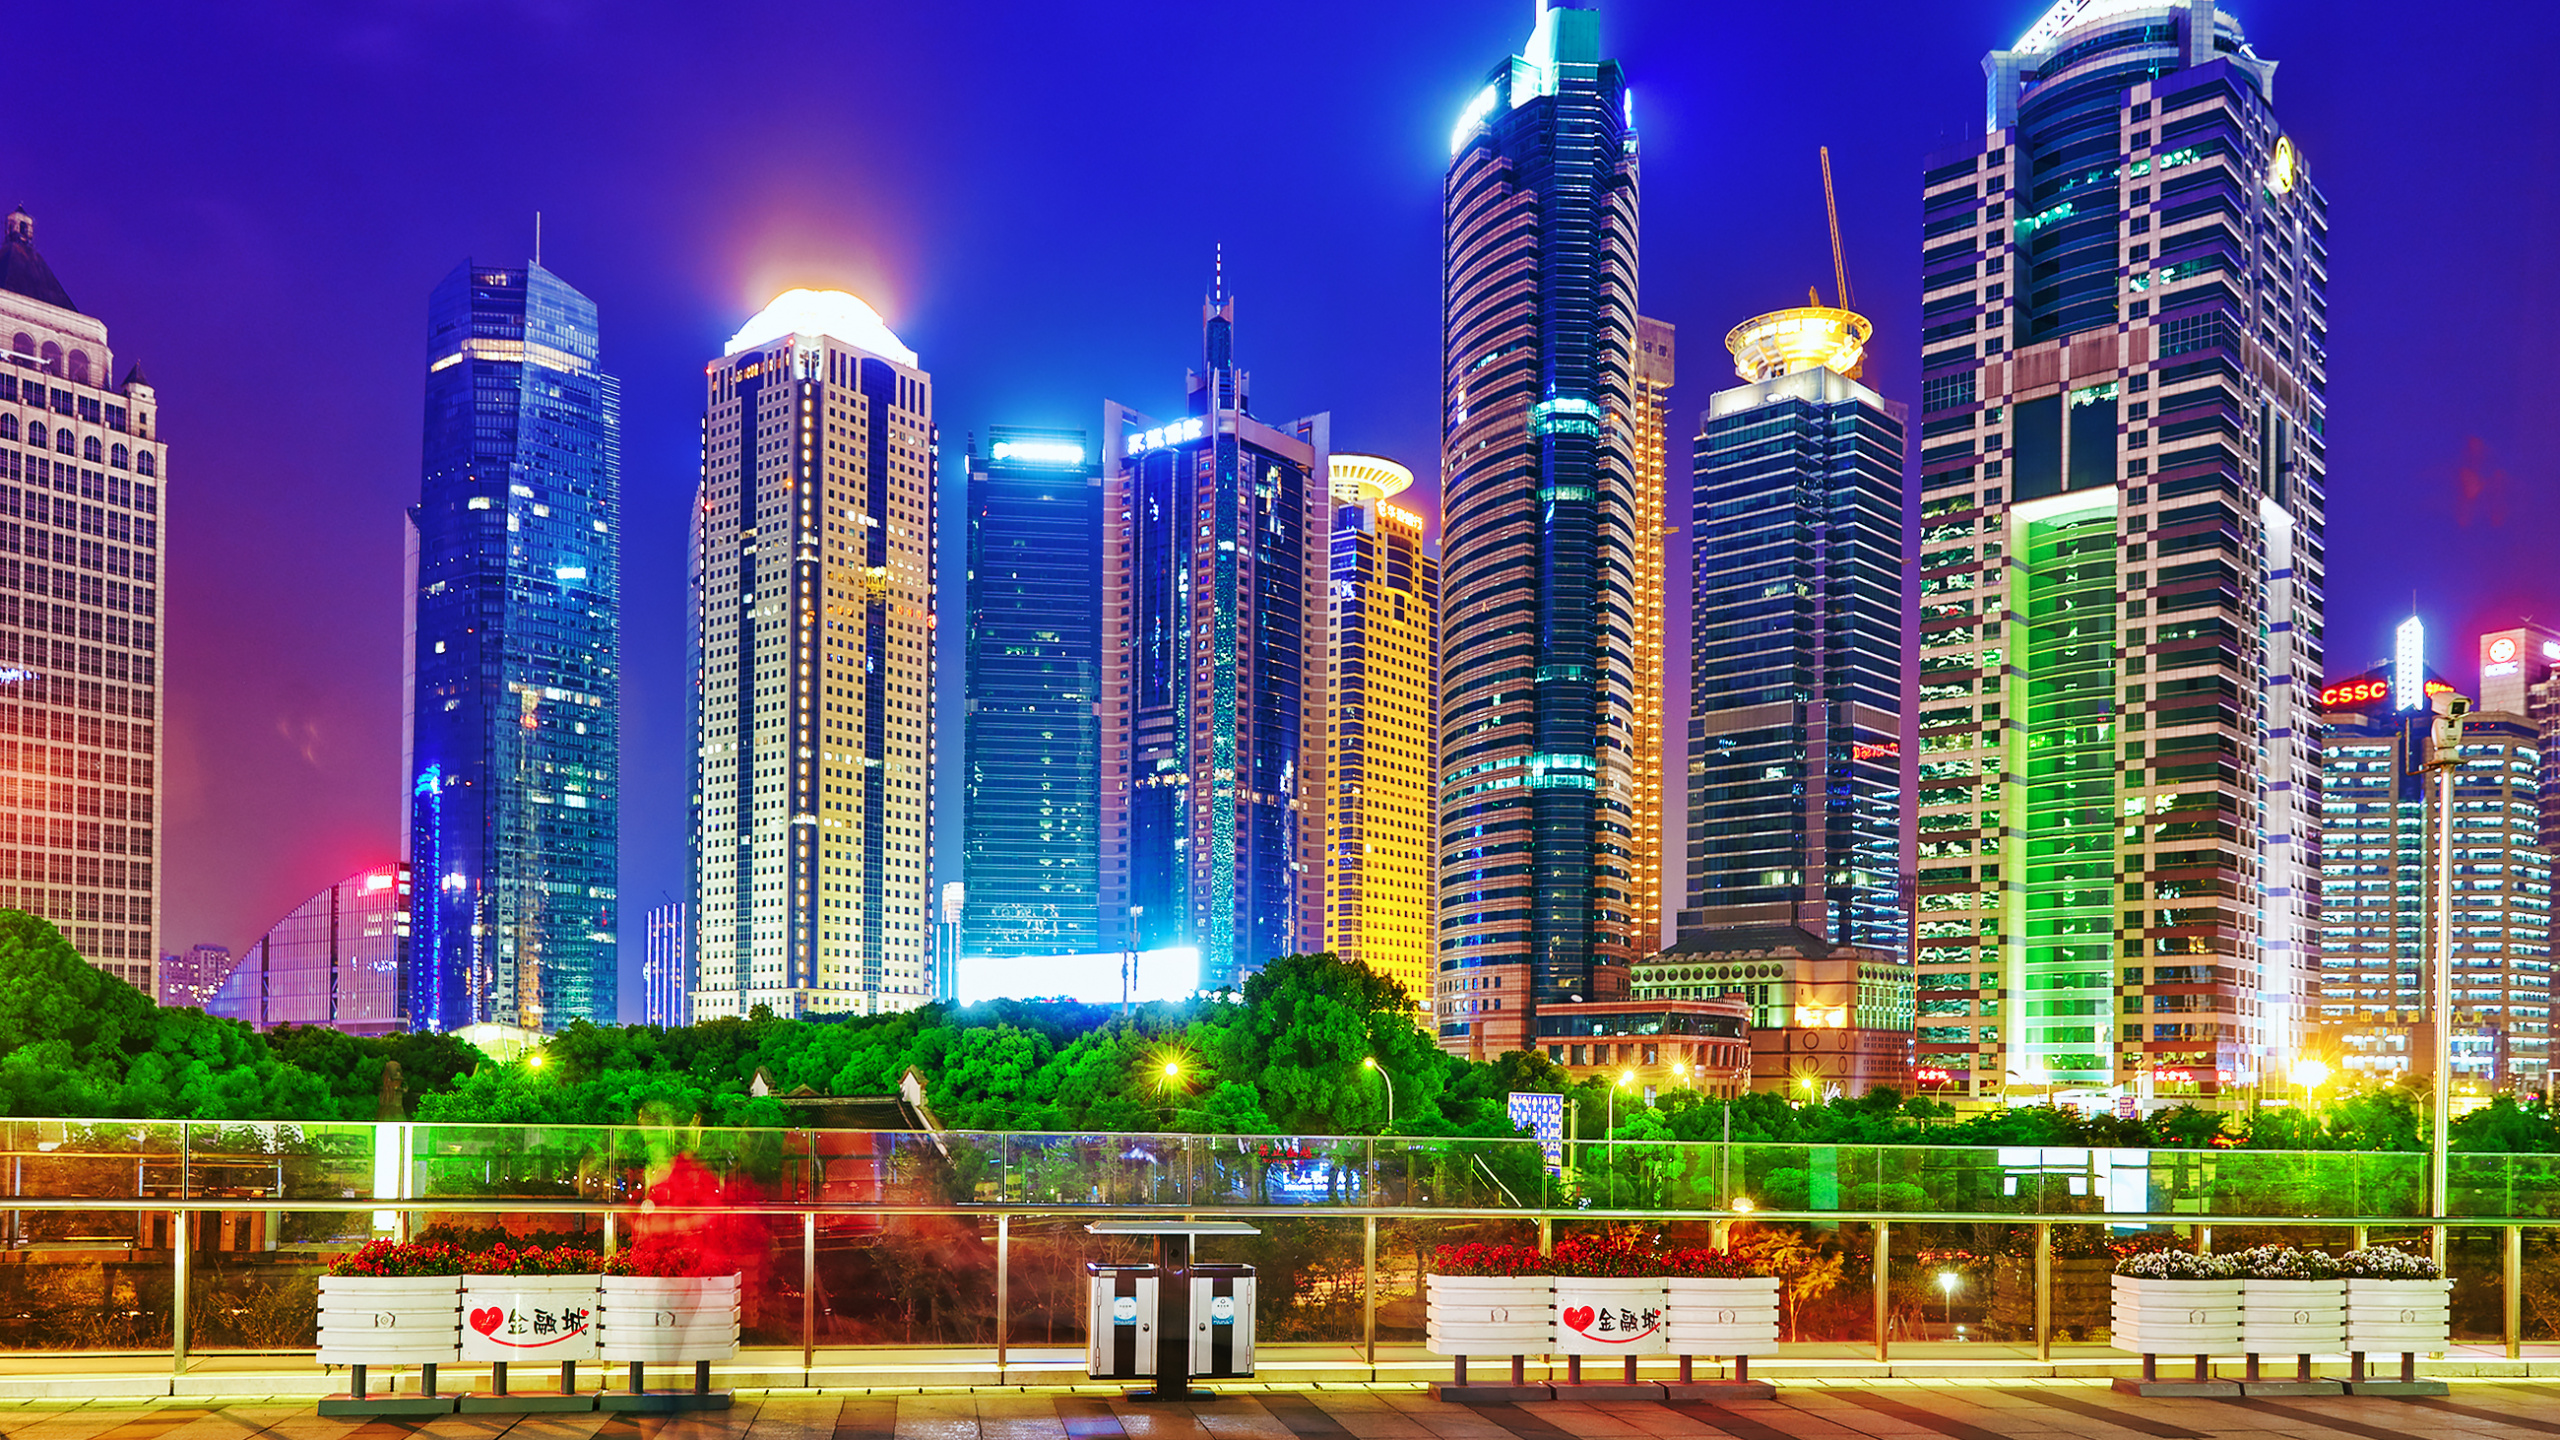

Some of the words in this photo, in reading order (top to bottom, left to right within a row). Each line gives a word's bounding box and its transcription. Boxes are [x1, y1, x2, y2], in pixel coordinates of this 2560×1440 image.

[2322, 681, 2387, 705] CSSC
[507, 1308, 587, 1336] 金融城
[1598, 1307, 1660, 1333] 金融城
